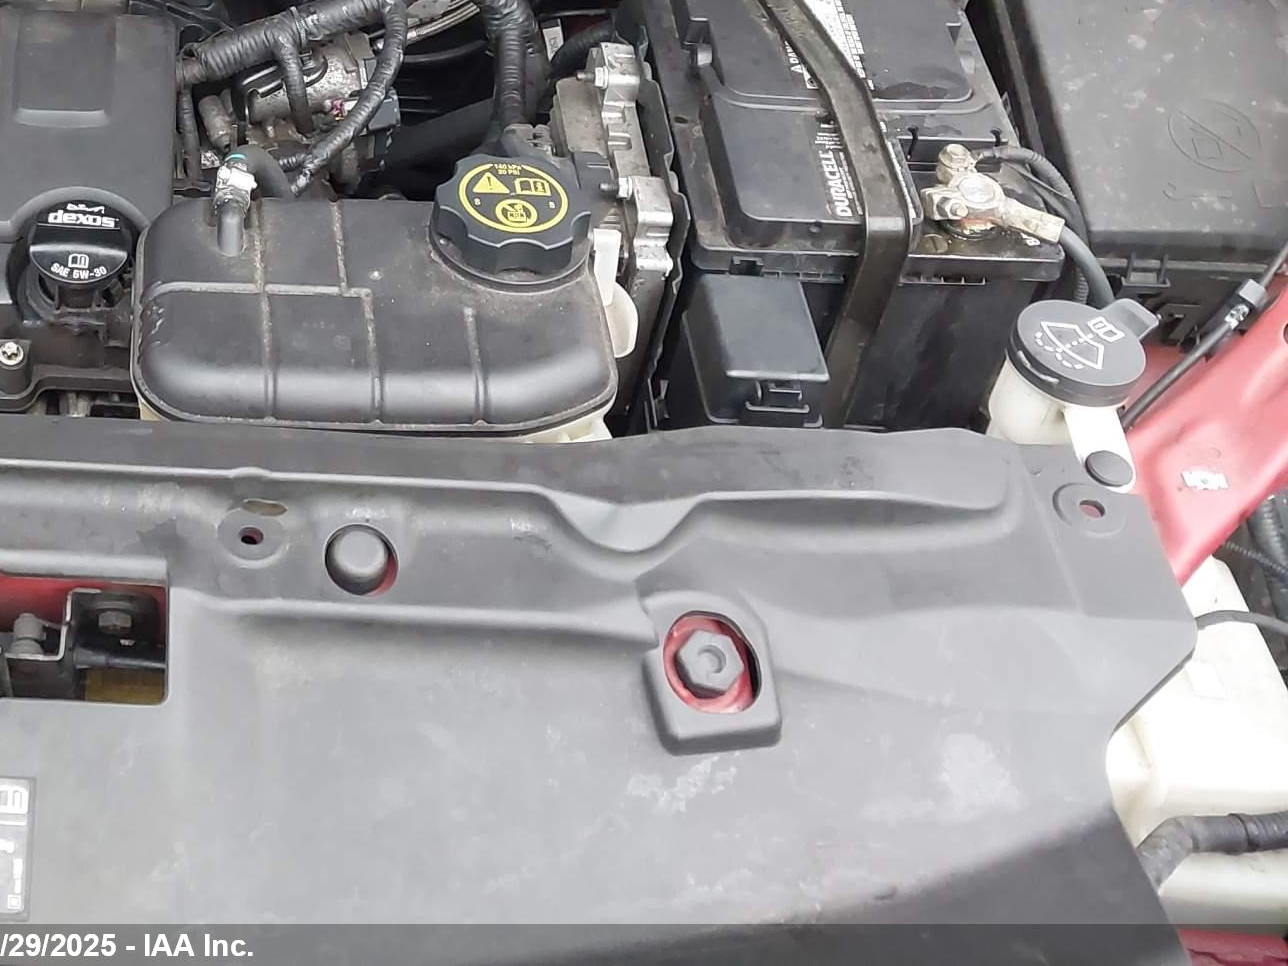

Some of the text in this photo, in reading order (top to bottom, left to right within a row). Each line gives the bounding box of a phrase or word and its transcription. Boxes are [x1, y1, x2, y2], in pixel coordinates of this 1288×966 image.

[819, 151, 852, 217] DURACELL
[47, 209, 115, 228] dexos
[50, 262, 71, 278] SAE
